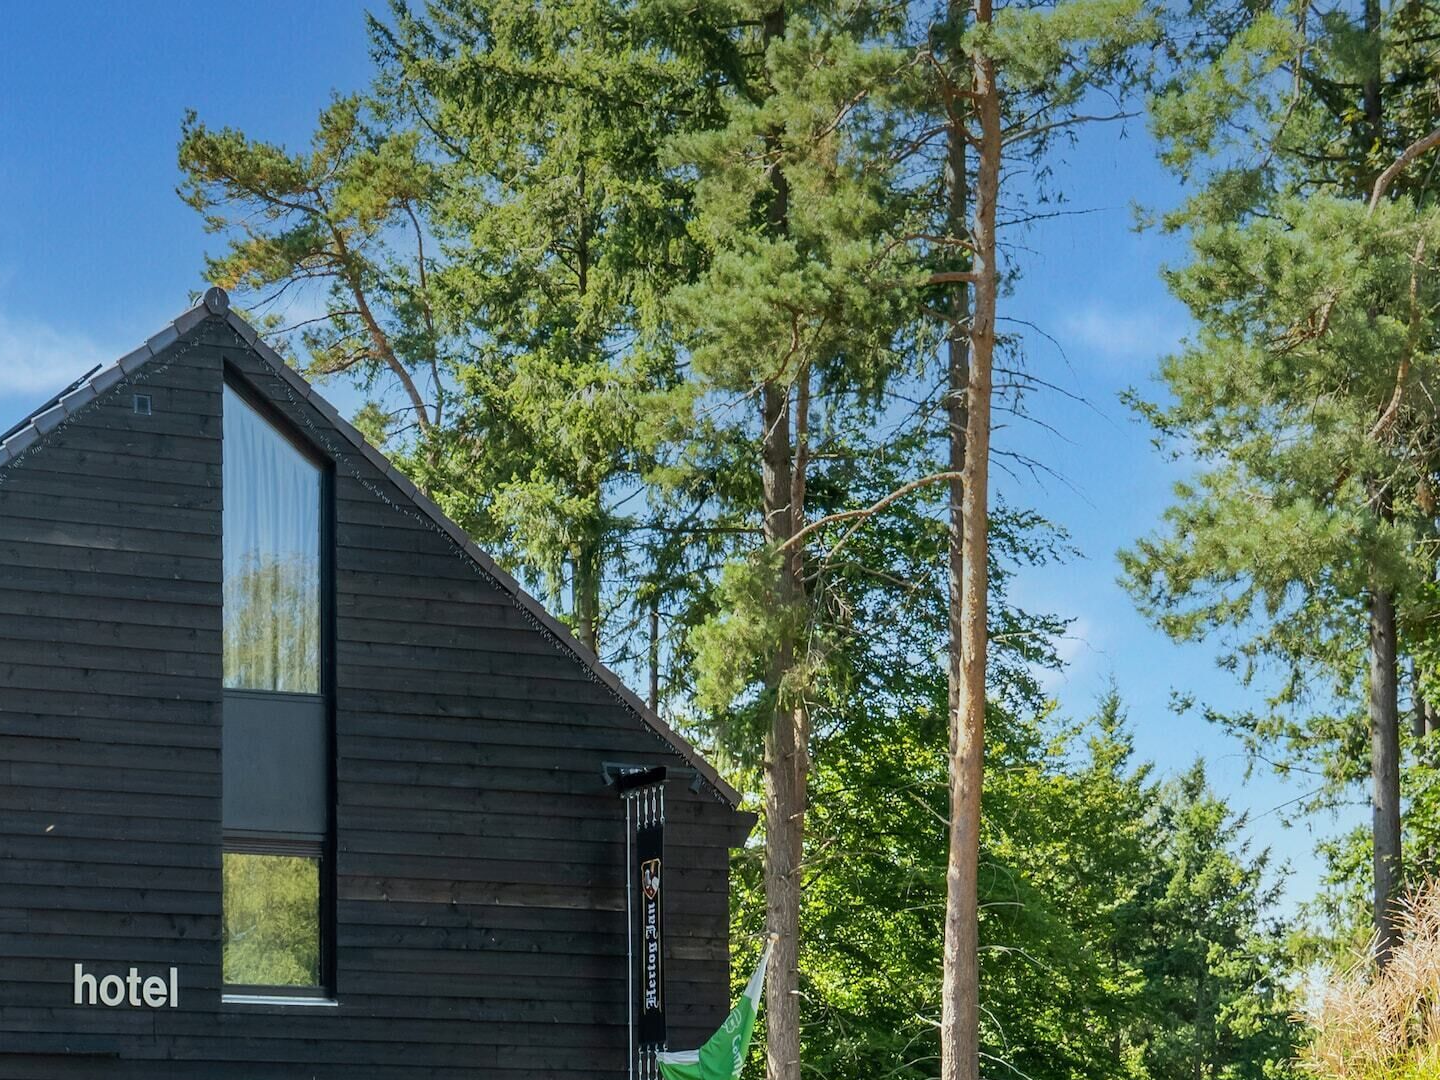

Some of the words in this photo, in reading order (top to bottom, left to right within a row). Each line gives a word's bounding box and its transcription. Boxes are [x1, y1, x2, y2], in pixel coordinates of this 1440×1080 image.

[646, 901, 658, 939] Jan
[74, 963, 178, 1008] hotel
[646, 942, 659, 1010] Hertog
